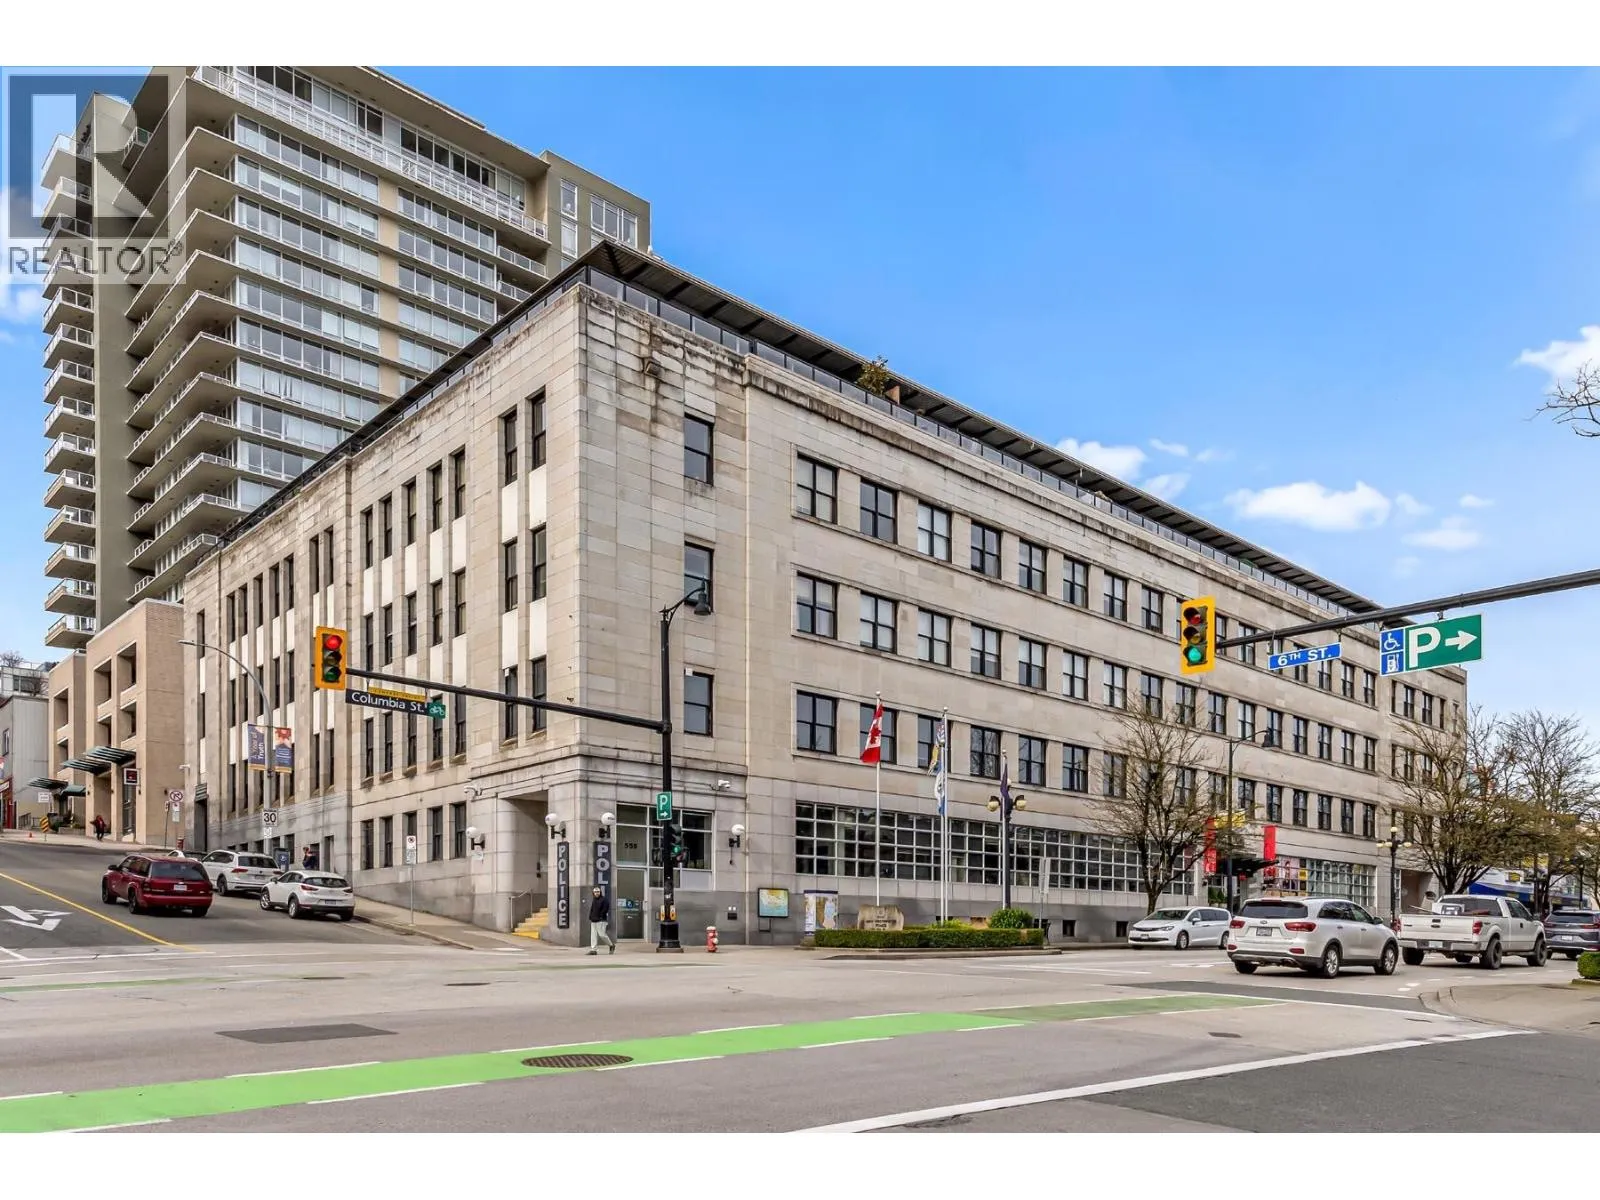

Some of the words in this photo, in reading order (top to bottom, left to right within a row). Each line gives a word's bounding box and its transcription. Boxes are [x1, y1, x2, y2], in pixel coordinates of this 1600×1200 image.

[1278, 652, 1300, 667] 6TH
[1307, 647, 1332, 662] ST.
[1408, 626, 1441, 668] P
[351, 691, 406, 710] Columbia
[410, 702, 425, 713] St.
[659, 795, 669, 810] P
[263, 812, 277, 823] 30
[558, 845, 567, 926] POLICE
